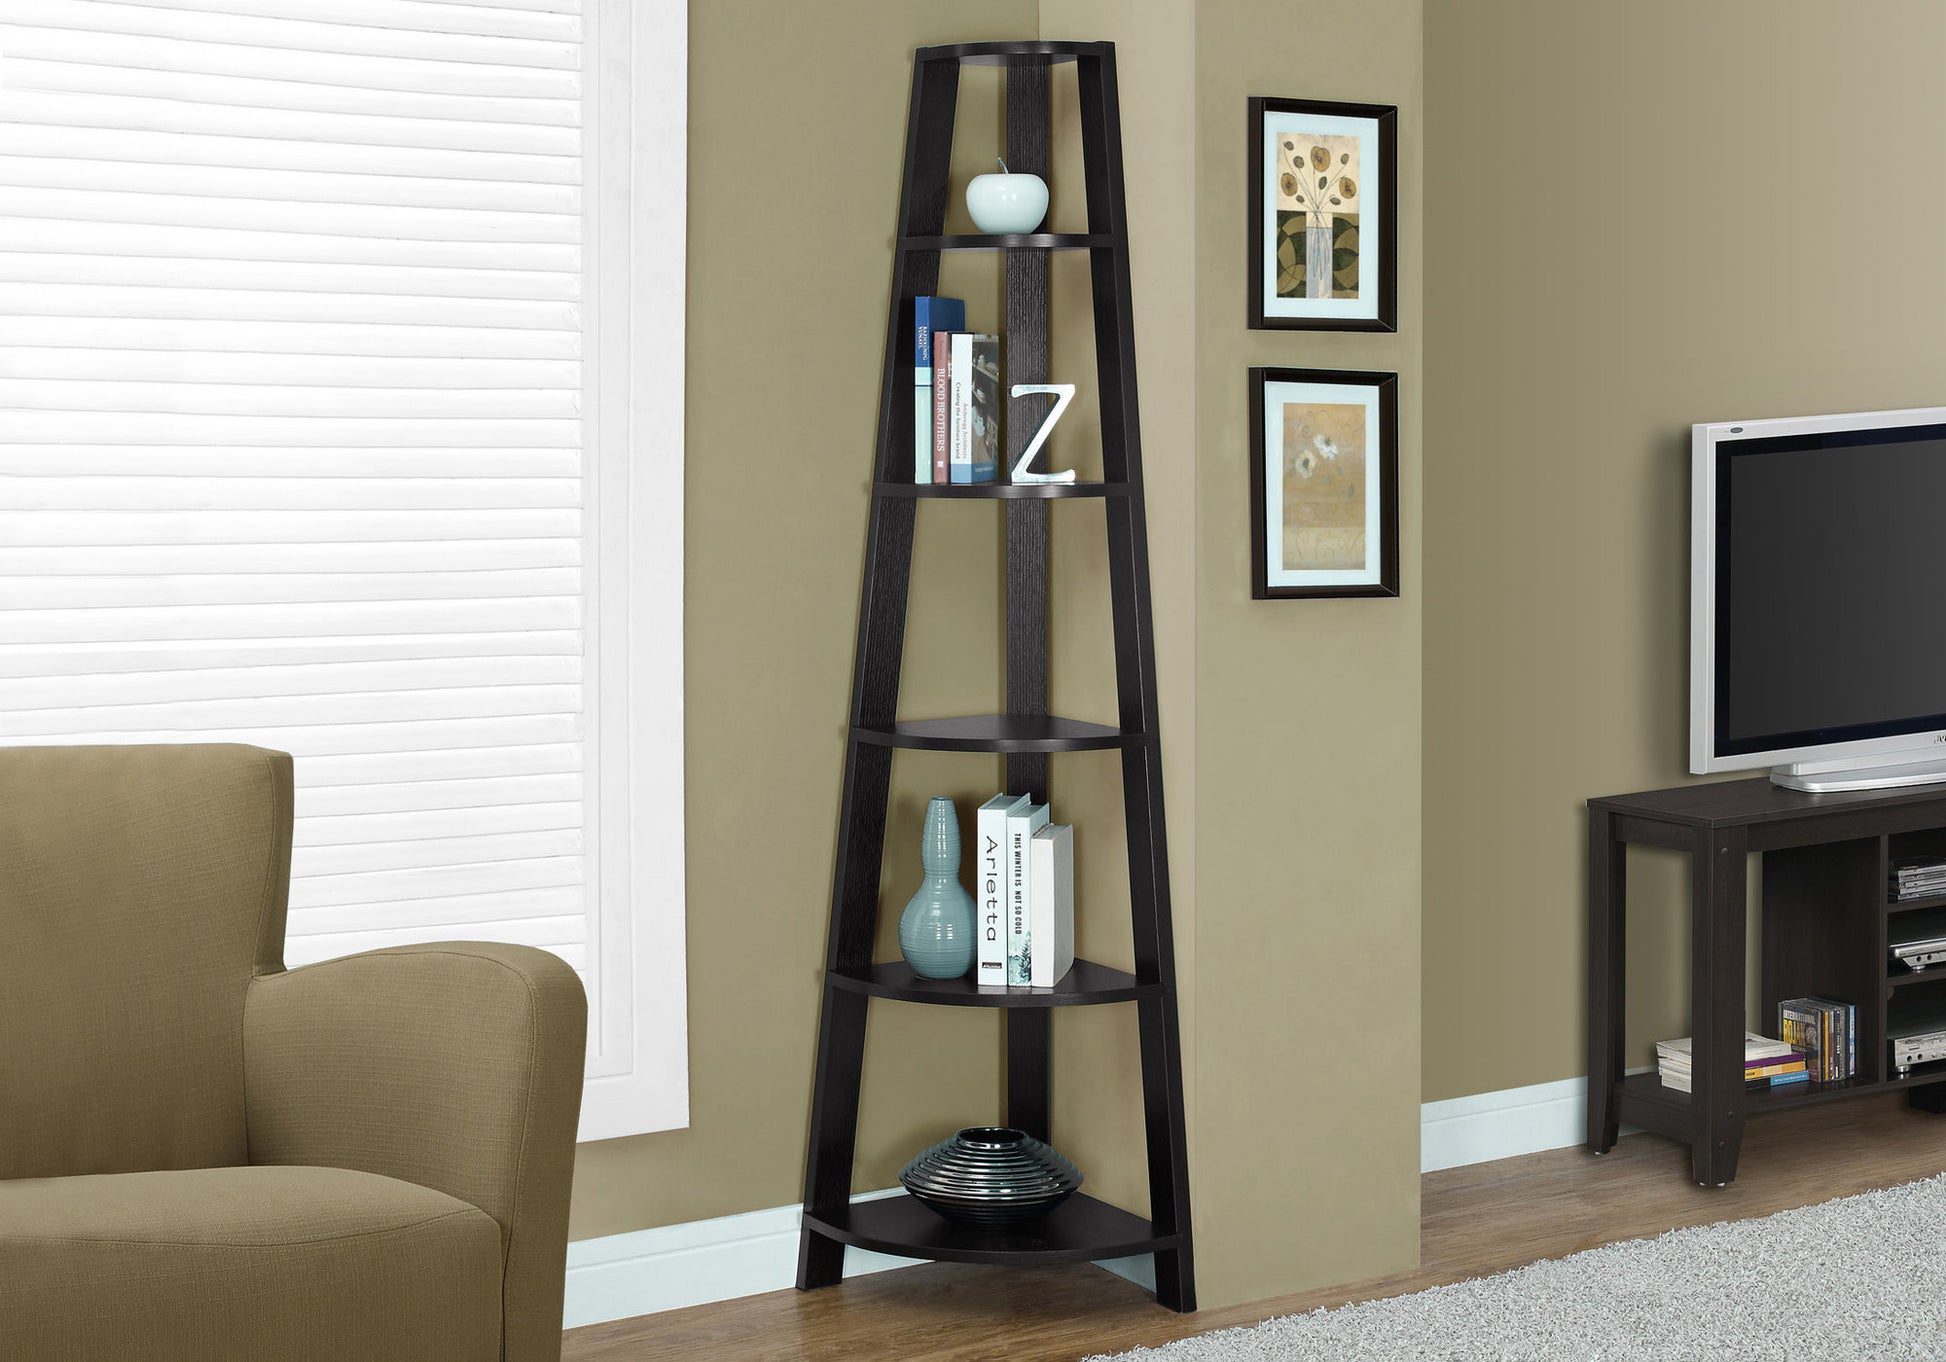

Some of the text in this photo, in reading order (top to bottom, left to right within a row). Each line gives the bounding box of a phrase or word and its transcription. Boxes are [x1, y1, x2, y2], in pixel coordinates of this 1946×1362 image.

[937, 368, 945, 401] BLOOD
[937, 402, 945, 452] BROTHERS
[1014, 833, 1022, 935] THIS WINTER IS NOT SO COLD
